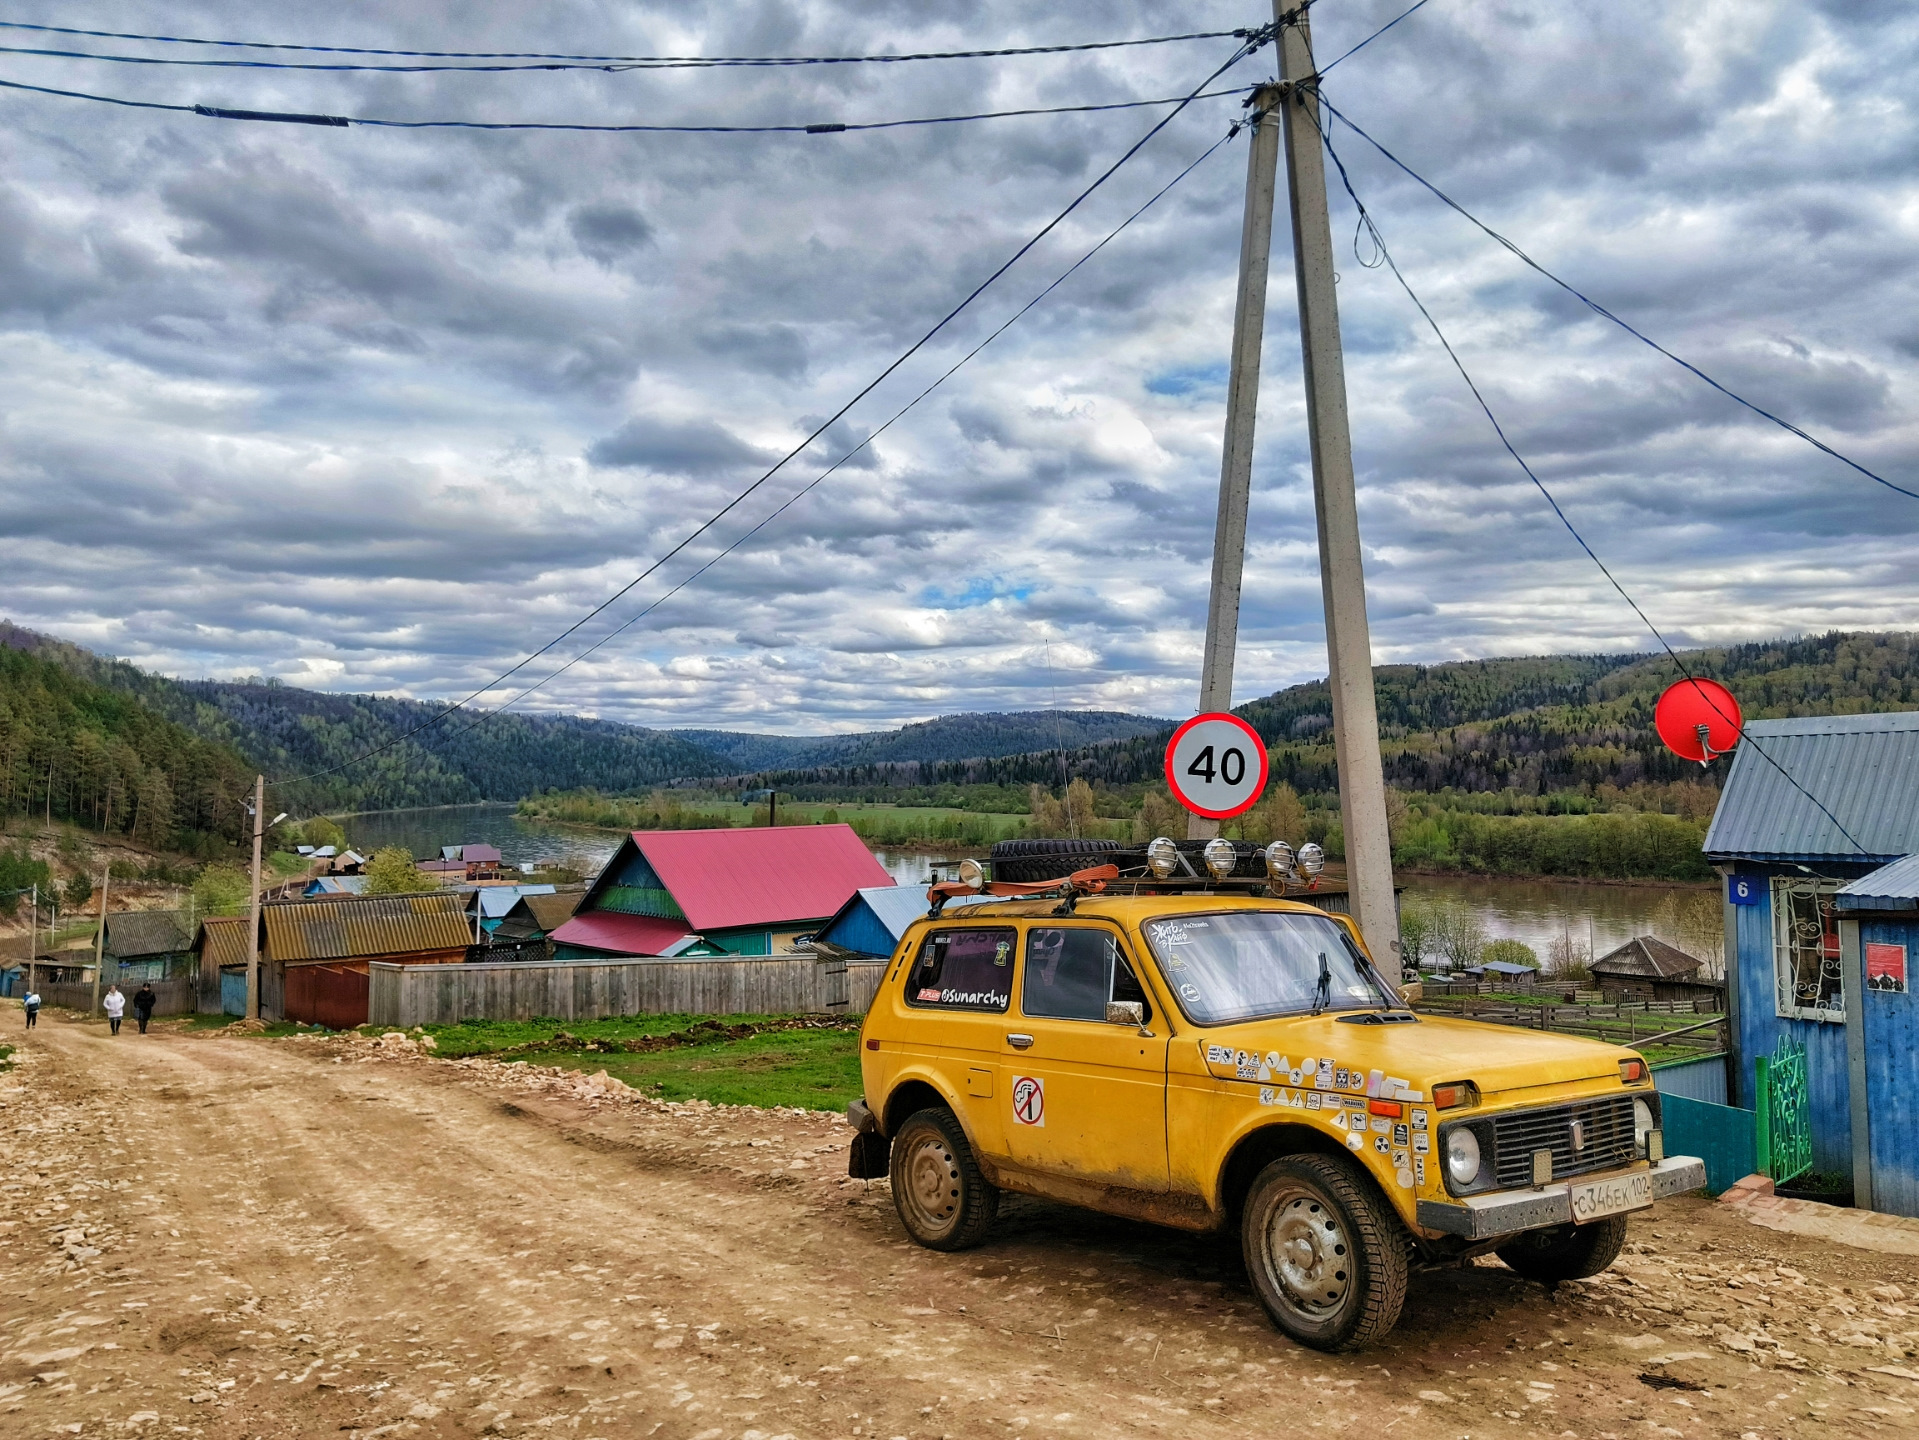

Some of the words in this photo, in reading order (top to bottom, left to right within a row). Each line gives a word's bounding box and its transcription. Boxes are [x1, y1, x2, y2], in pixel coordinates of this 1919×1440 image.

[1187, 745, 1246, 786] 40
[1736, 881, 1750, 898] 6
[1631, 1176, 1648, 1196] 102
